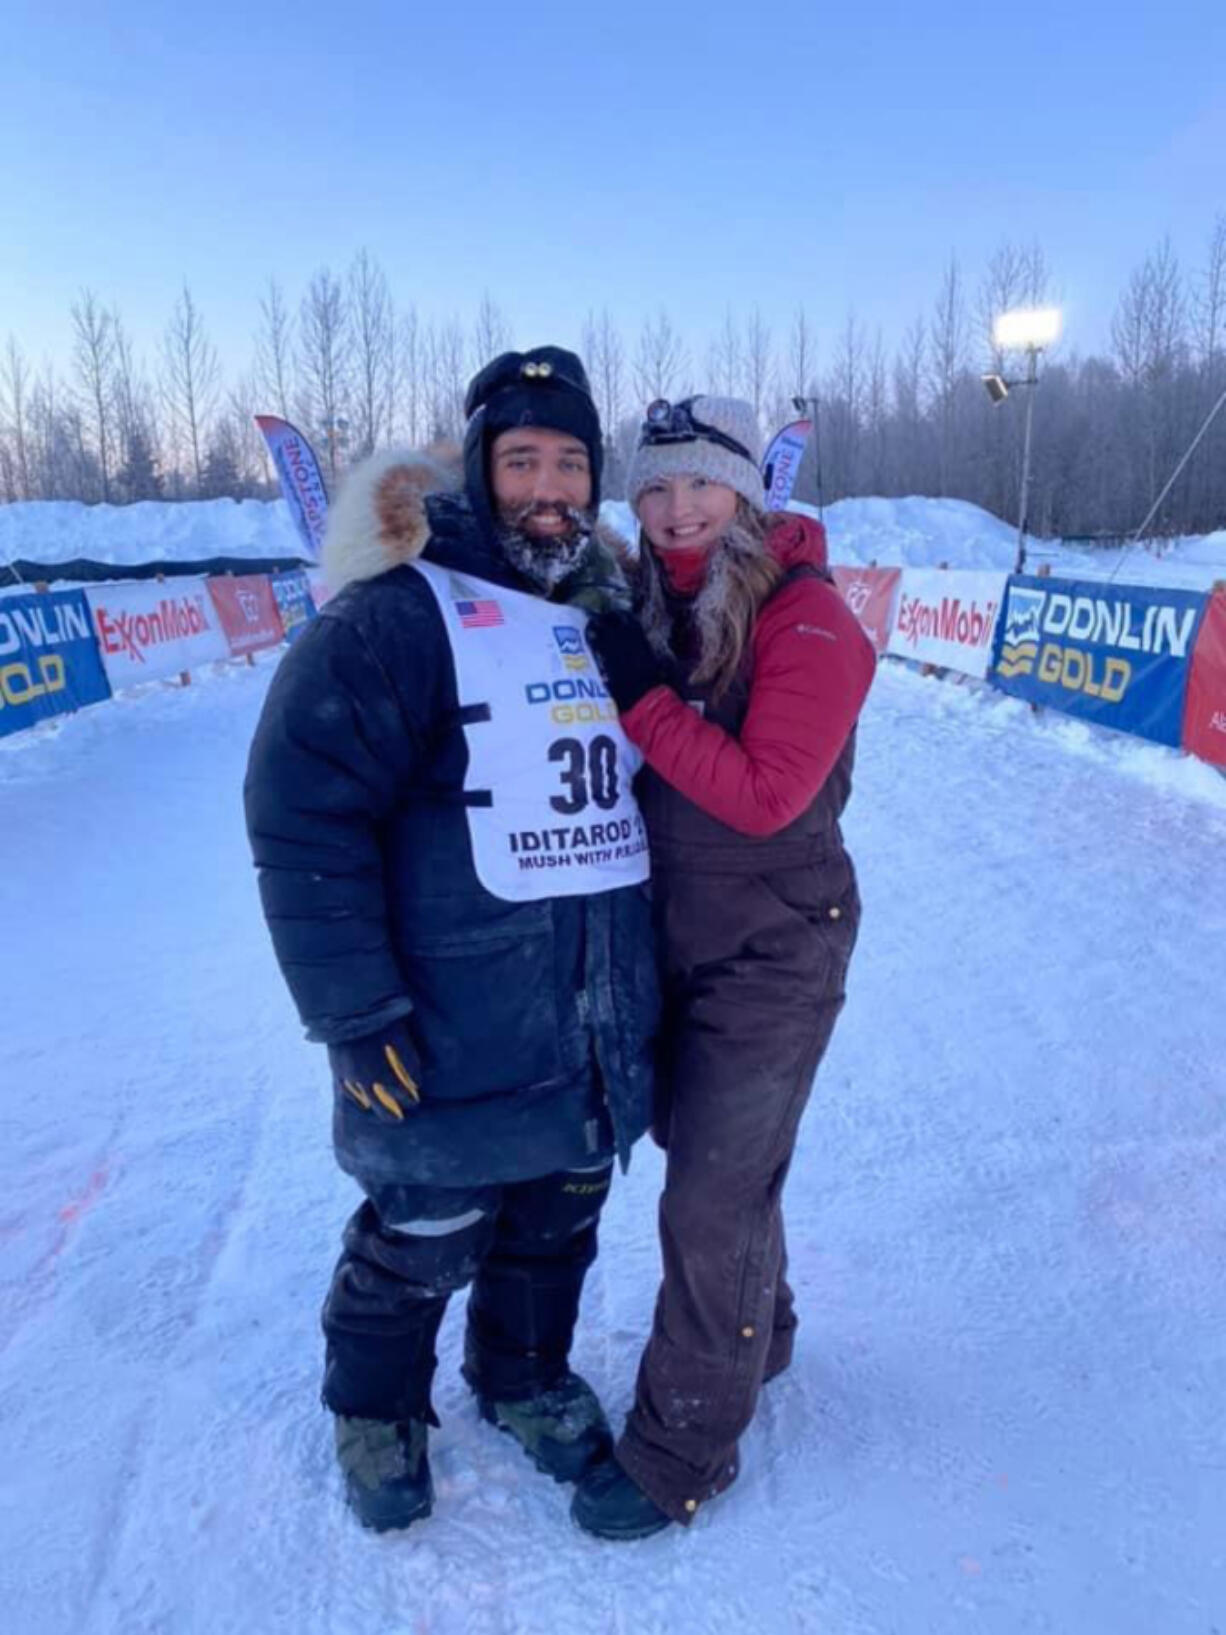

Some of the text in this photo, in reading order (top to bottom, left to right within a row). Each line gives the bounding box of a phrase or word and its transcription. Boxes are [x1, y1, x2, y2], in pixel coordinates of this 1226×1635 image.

[897, 592, 998, 649] ExxonMobil
[1043, 593, 1197, 658] DONLIN
[0, 654, 66, 711] OLD
[1037, 644, 1131, 704] GOLD
[548, 734, 619, 817] 30
[508, 818, 631, 853] IDITAROD
[518, 854, 571, 871] MUSH
[574, 848, 612, 867] WITH
